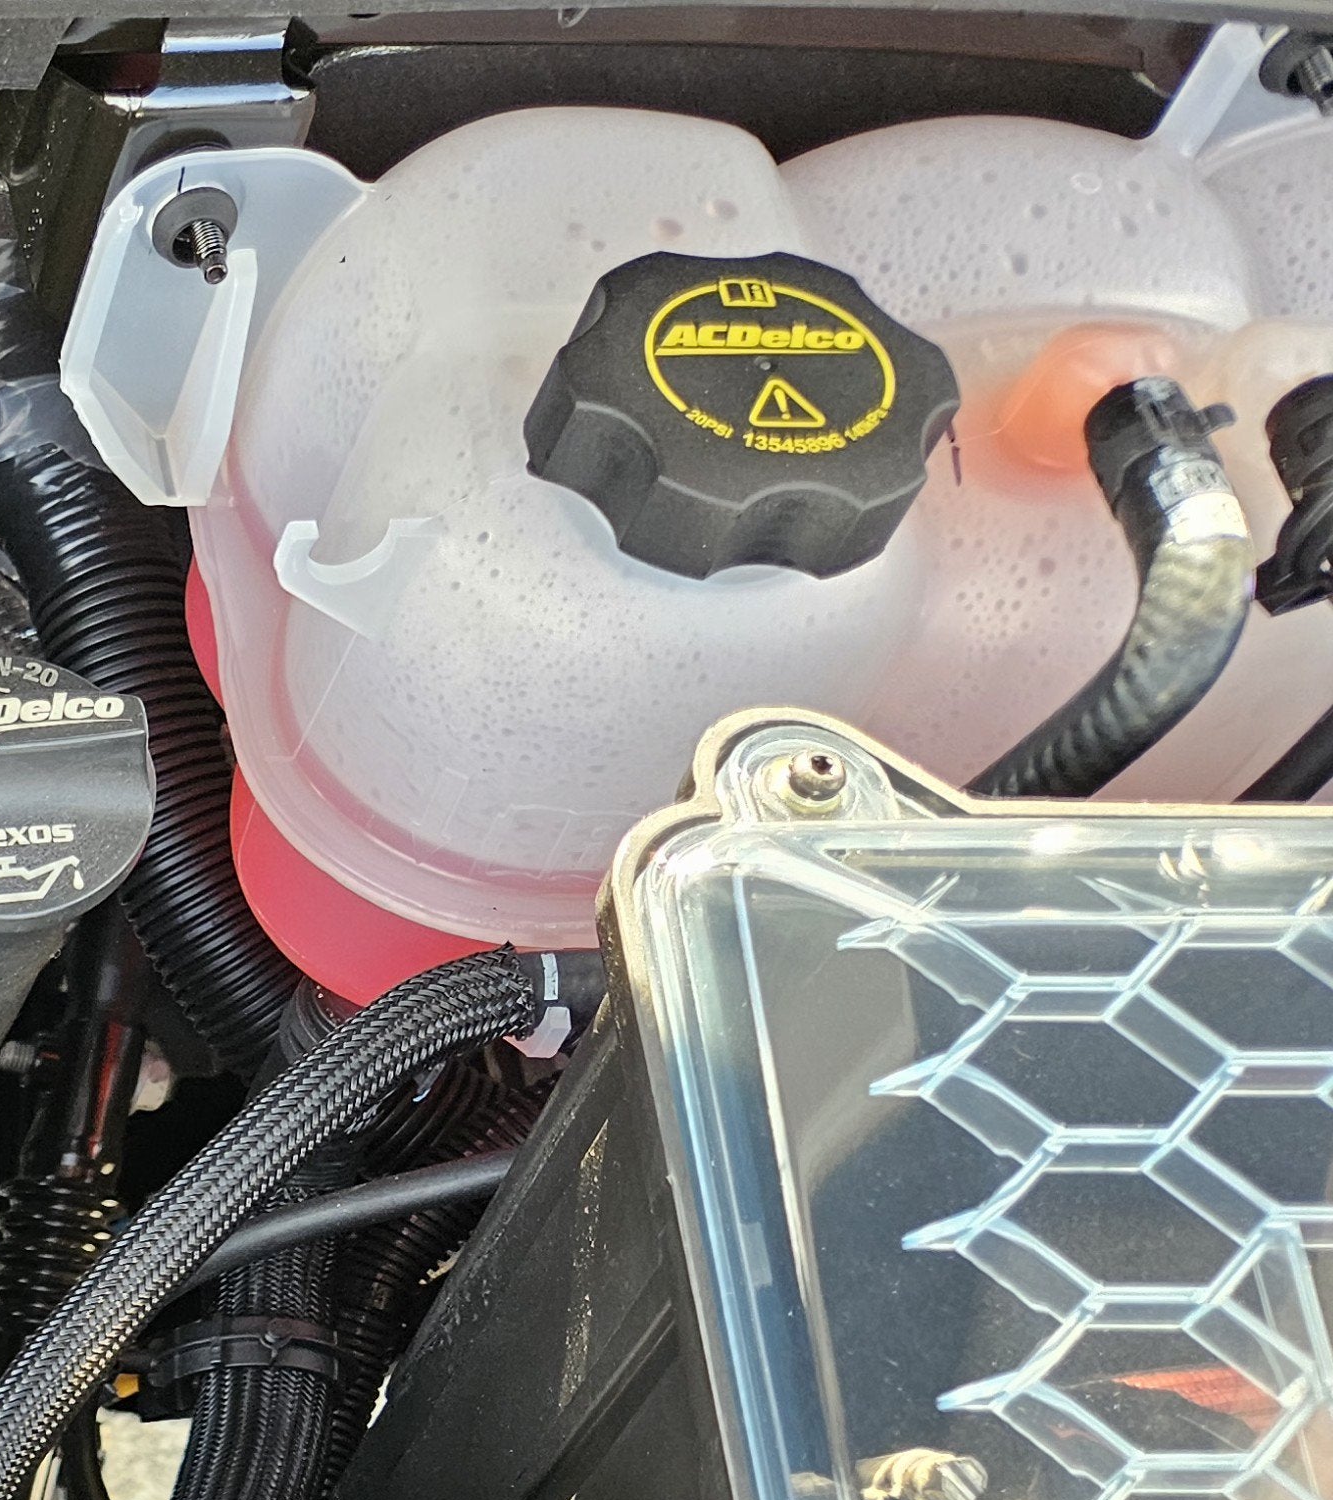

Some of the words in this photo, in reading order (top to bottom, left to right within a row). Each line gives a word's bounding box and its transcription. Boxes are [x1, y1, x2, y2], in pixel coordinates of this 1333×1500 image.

[660, 323, 866, 351] ACDelco
[685, 408, 734, 440] 20PSI
[743, 431, 847, 455] 13545896
